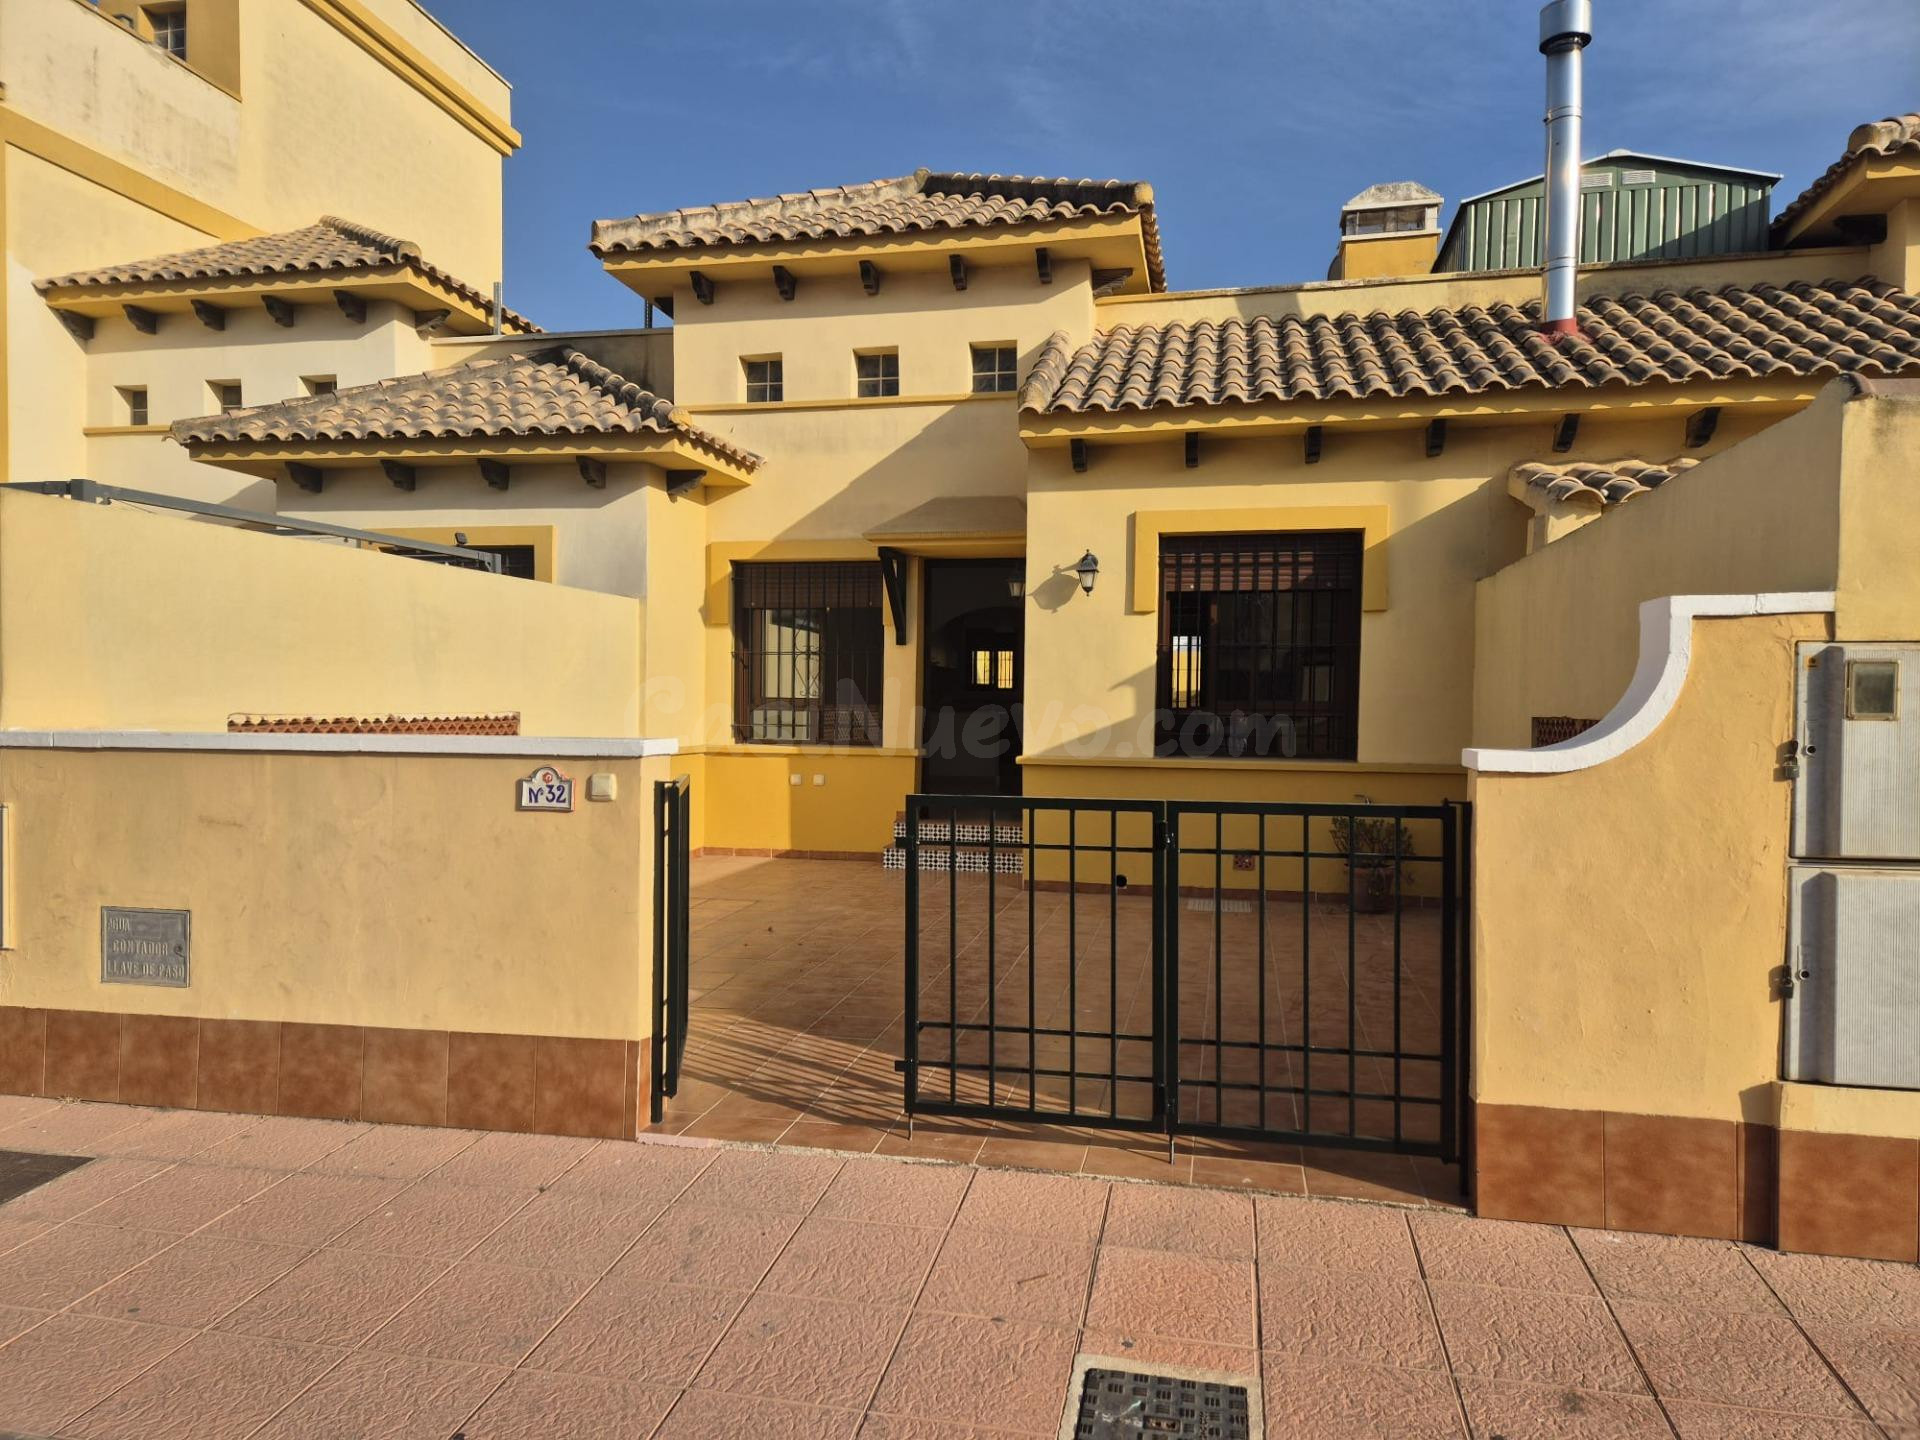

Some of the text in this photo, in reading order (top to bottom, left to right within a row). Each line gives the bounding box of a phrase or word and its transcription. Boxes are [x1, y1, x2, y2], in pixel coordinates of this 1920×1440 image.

[112, 938, 169, 957] CONTADOR
[107, 959, 185, 980] LLAVE DE PASO
